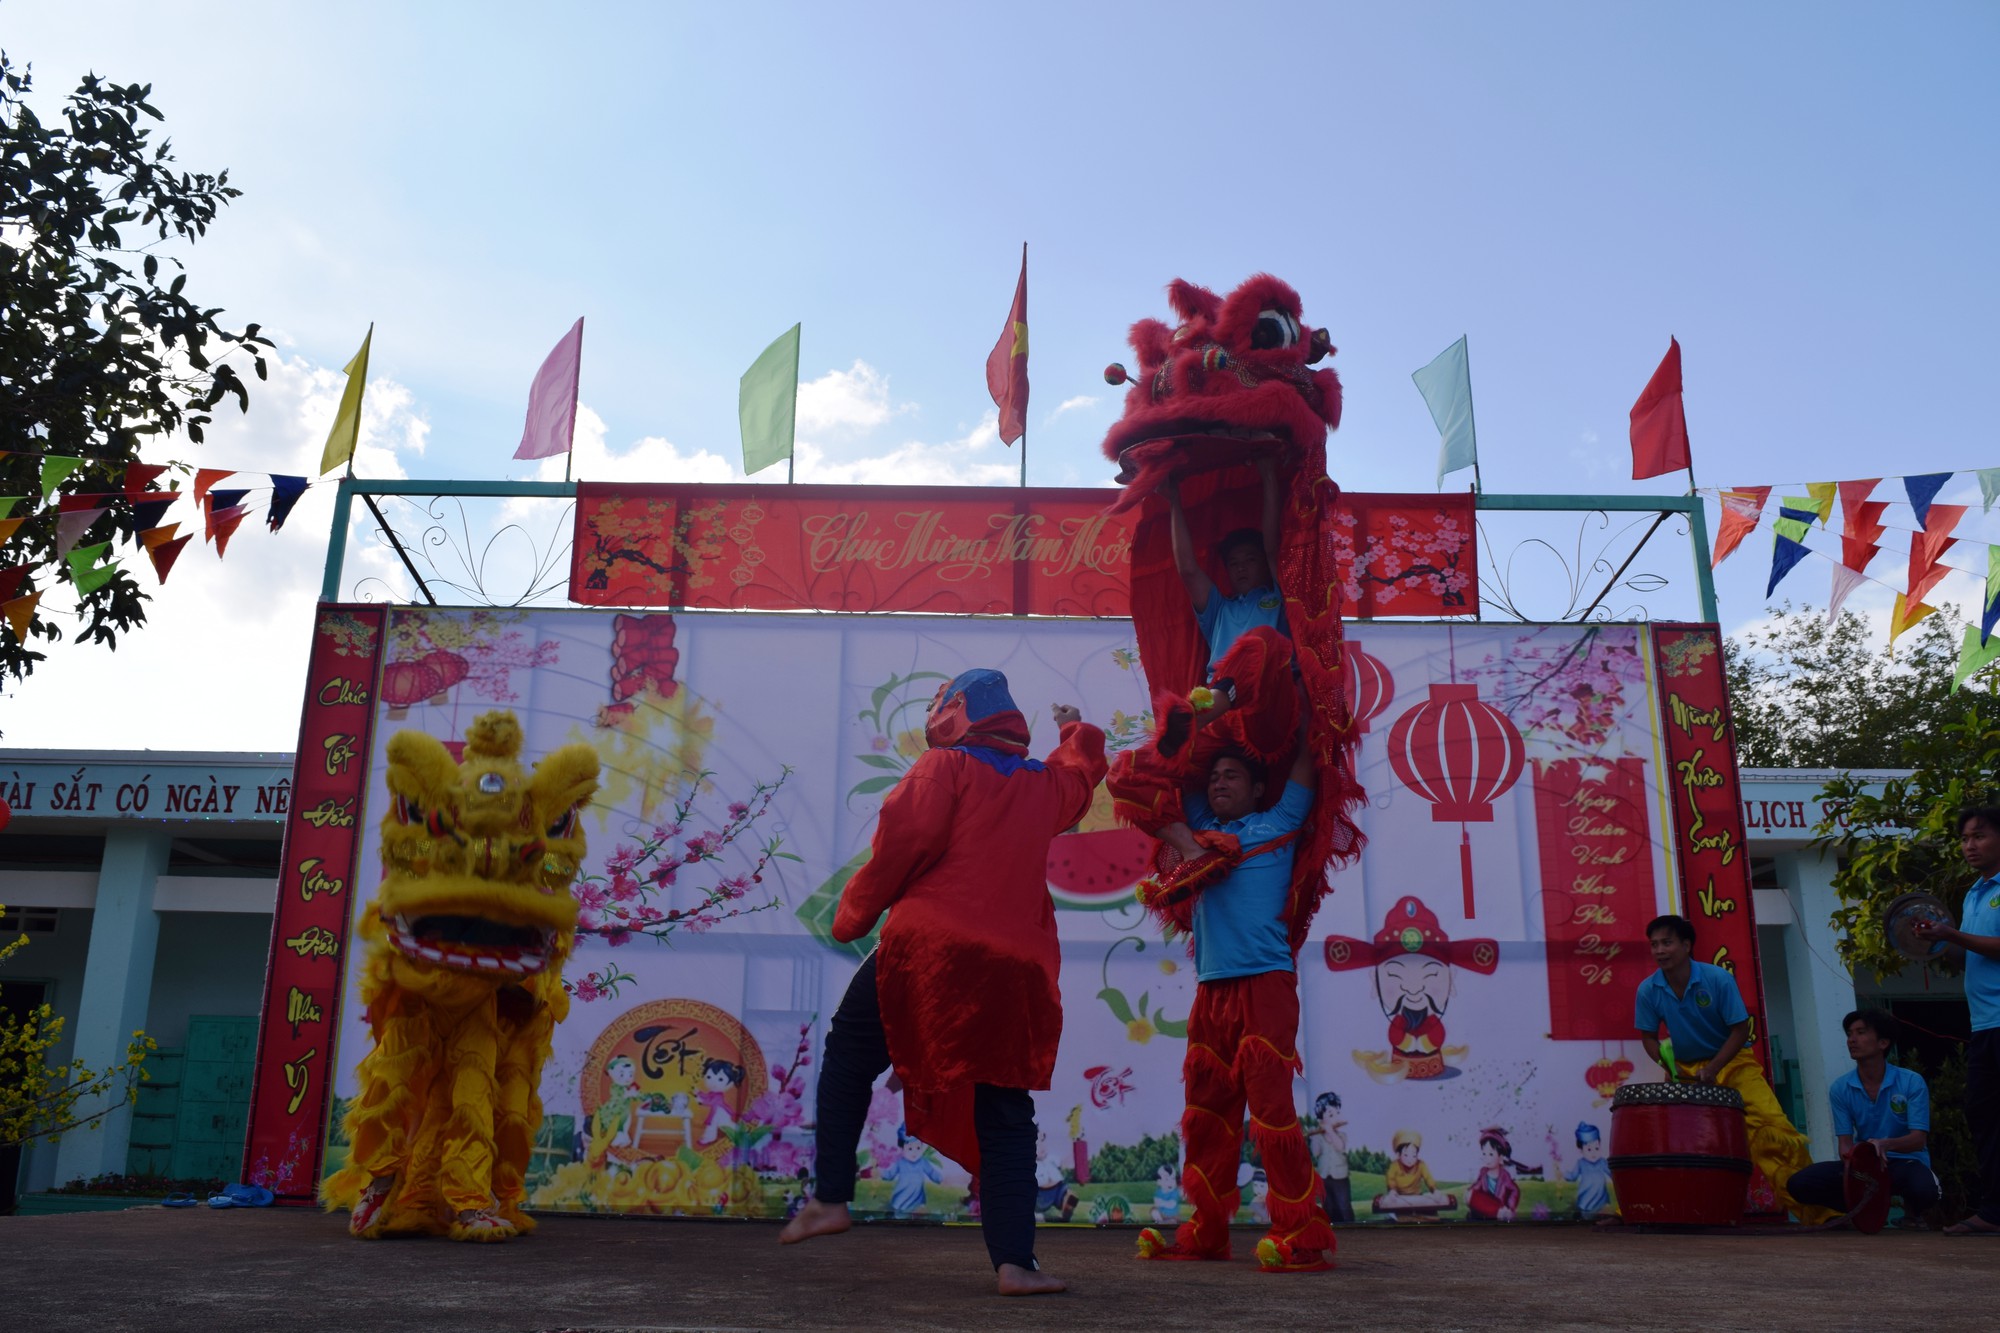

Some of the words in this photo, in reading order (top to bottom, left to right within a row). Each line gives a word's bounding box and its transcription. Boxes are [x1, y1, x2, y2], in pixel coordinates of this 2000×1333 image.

[802, 511, 896, 573] Chúc
[876, 510, 991, 582] Mừng
[983, 513, 1066, 565] Năm
[319, 677, 369, 705] Chúc
[323, 735, 356, 776] Tết
[1677, 748, 1725, 802] Xuân
[50, 766, 102, 811] SẮT
[116, 773, 151, 812] CÓ
[165, 774, 240, 814] NGÀY
[1559, 786, 1620, 813] Ngày
[303, 798, 355, 829] Đến
[1564, 815, 1628, 836] Xuân
[1744, 801, 1808, 835] LỊCH
[1689, 819, 1737, 866] Sang
[1569, 873, 1617, 895] Hoa
[1697, 876, 1737, 919] Vạn
[633, 1025, 700, 1080] Tết
[284, 1048, 316, 1115] Ý
[1083, 1064, 1137, 1111] Tết
